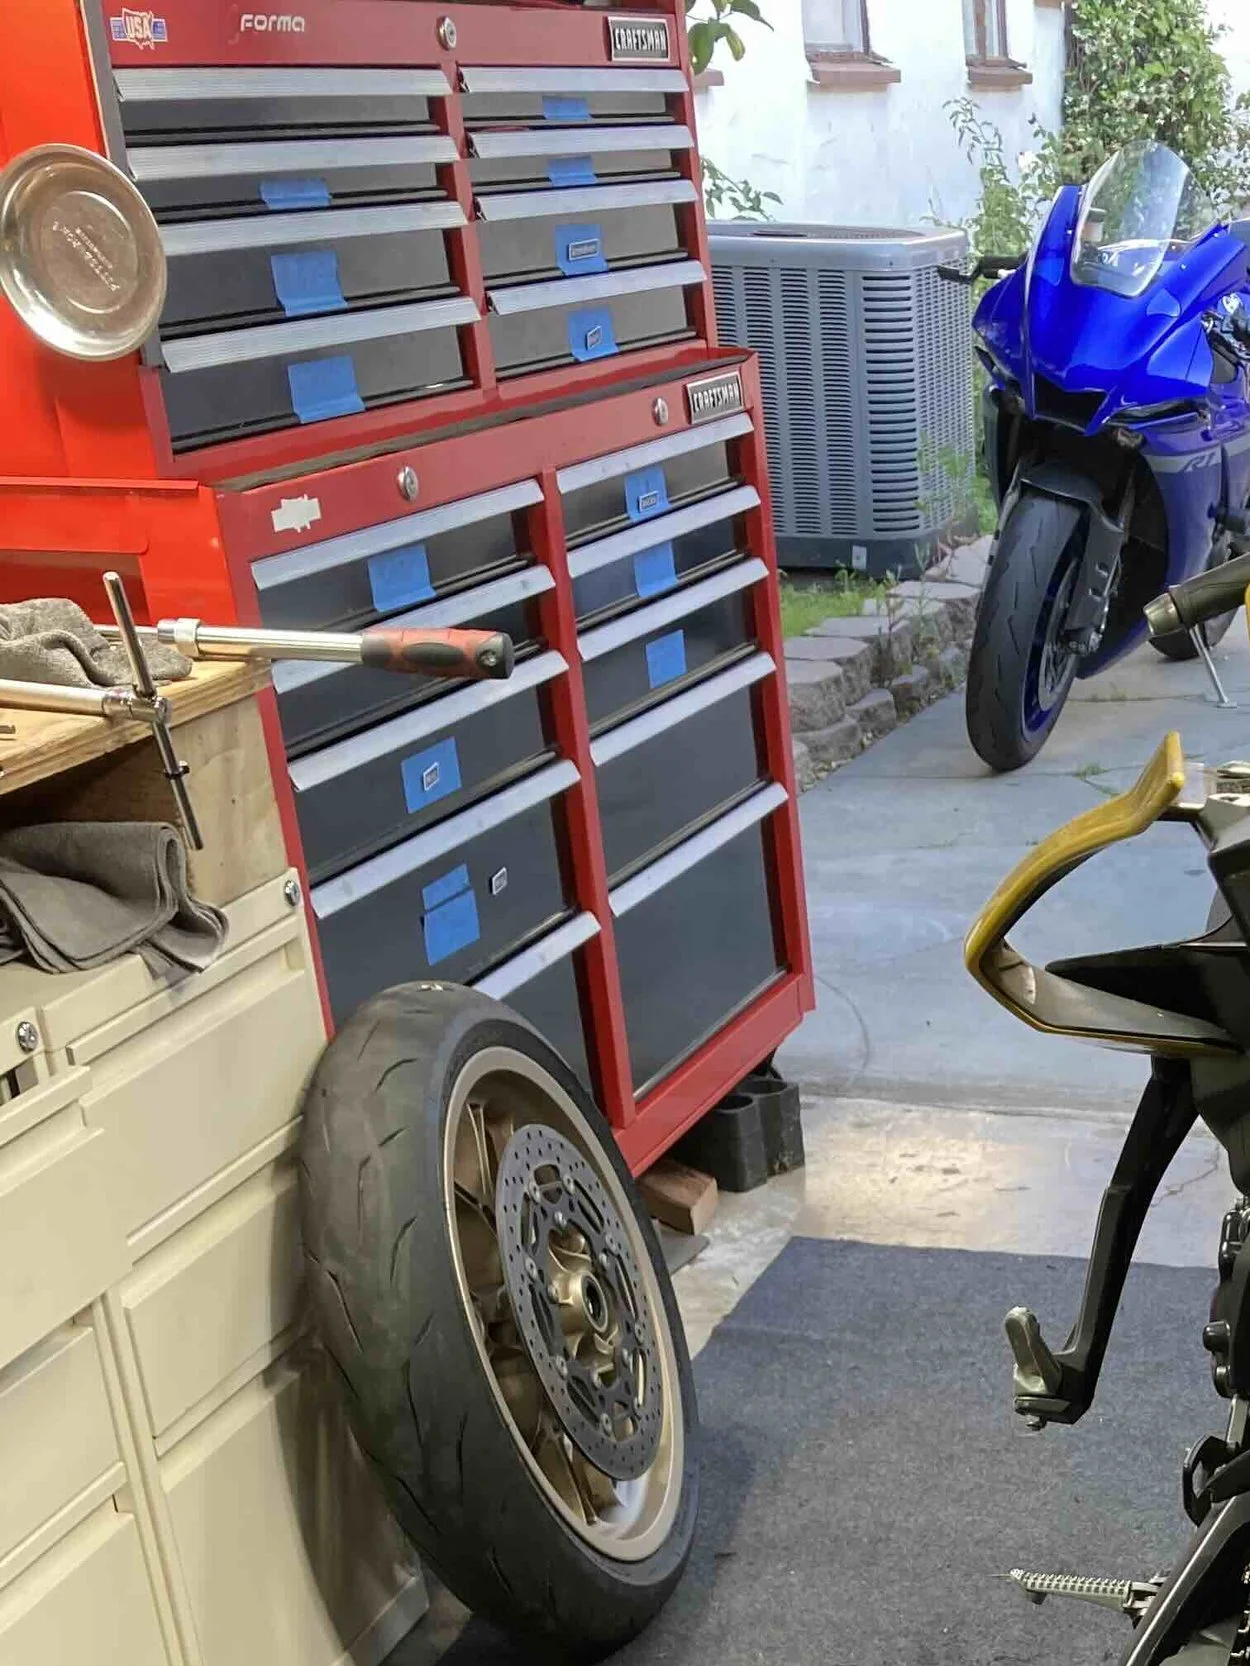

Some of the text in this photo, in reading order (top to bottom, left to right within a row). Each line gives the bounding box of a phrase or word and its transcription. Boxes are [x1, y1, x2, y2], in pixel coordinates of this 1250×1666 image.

[126, 16, 152, 39] USA
[613, 27, 667, 51] CRAFTSMAN
[693, 382, 740, 412] CRAFTSMAN
[1184, 451, 1217, 472] R1
